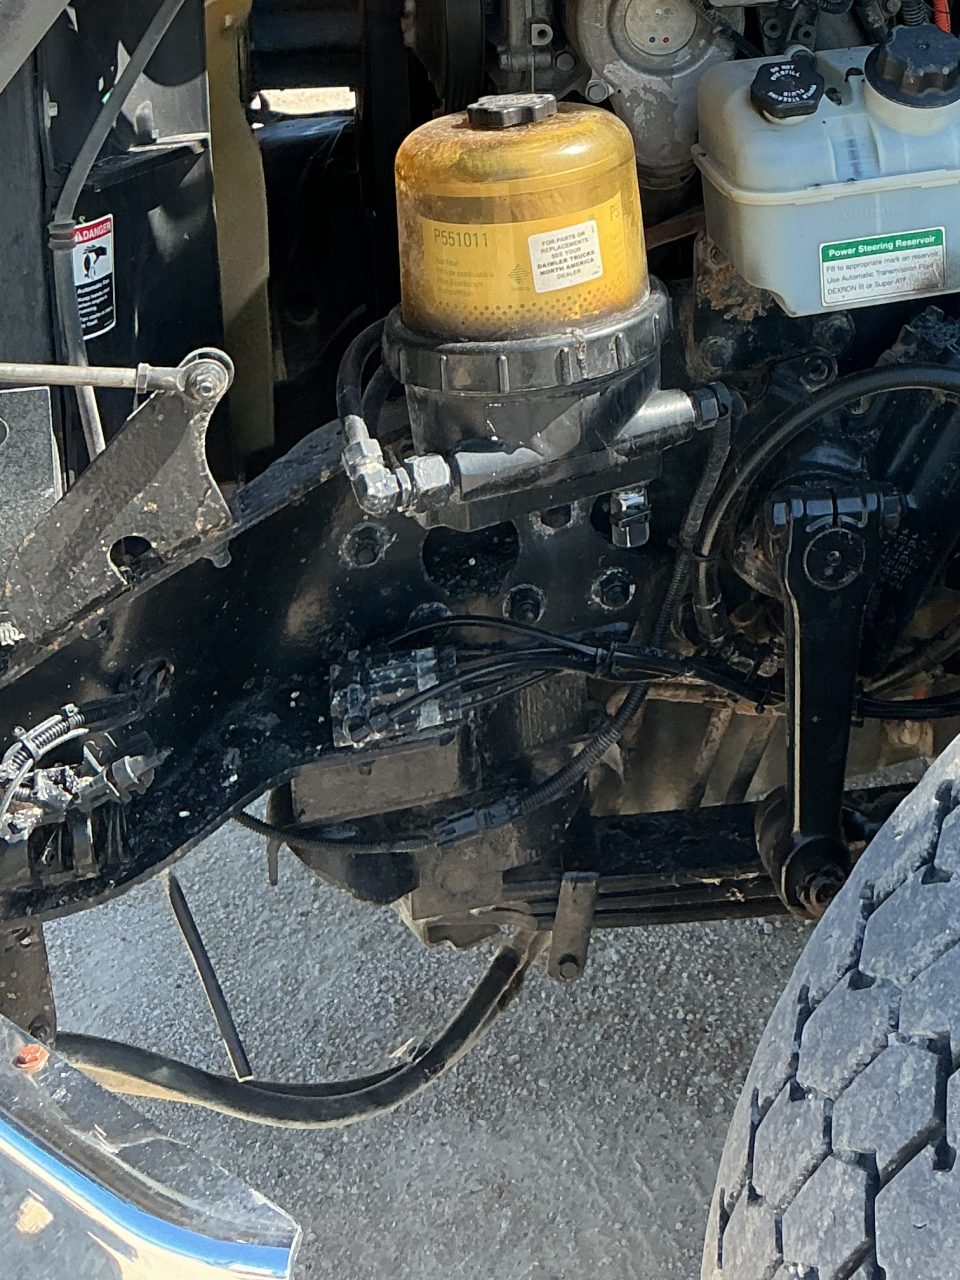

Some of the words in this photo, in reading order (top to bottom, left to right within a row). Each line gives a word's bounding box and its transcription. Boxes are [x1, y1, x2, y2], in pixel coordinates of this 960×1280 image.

[82, 221, 111, 240] DANGER
[433, 228, 489, 248] P551011
[540, 237, 589, 254] REPLACEMENTS
[541, 238, 555, 247] FOR
[556, 233, 576, 243] PARTS
[828, 247, 856, 258] Power
[858, 241, 894, 254] Steering
[895, 234, 937, 248] Reservoir
[537, 258, 568, 269] DAIMLER
[569, 250, 595, 261] TRUCKS
[565, 246, 582, 256] YOUR
[540, 266, 564, 276] NORTH
[566, 257, 595, 270] AMERICA
[826, 265, 836, 273] Fill
[845, 260, 882, 271] appropriate
[884, 256, 900, 265] mark
[557, 269, 582, 280] DEALER
[827, 276, 840, 284] Use
[841, 271, 874, 282] Automatic
[875, 264, 917, 276] Transmission
[827, 285, 857, 295] DEXRON
[874, 279, 894, 289] Super
